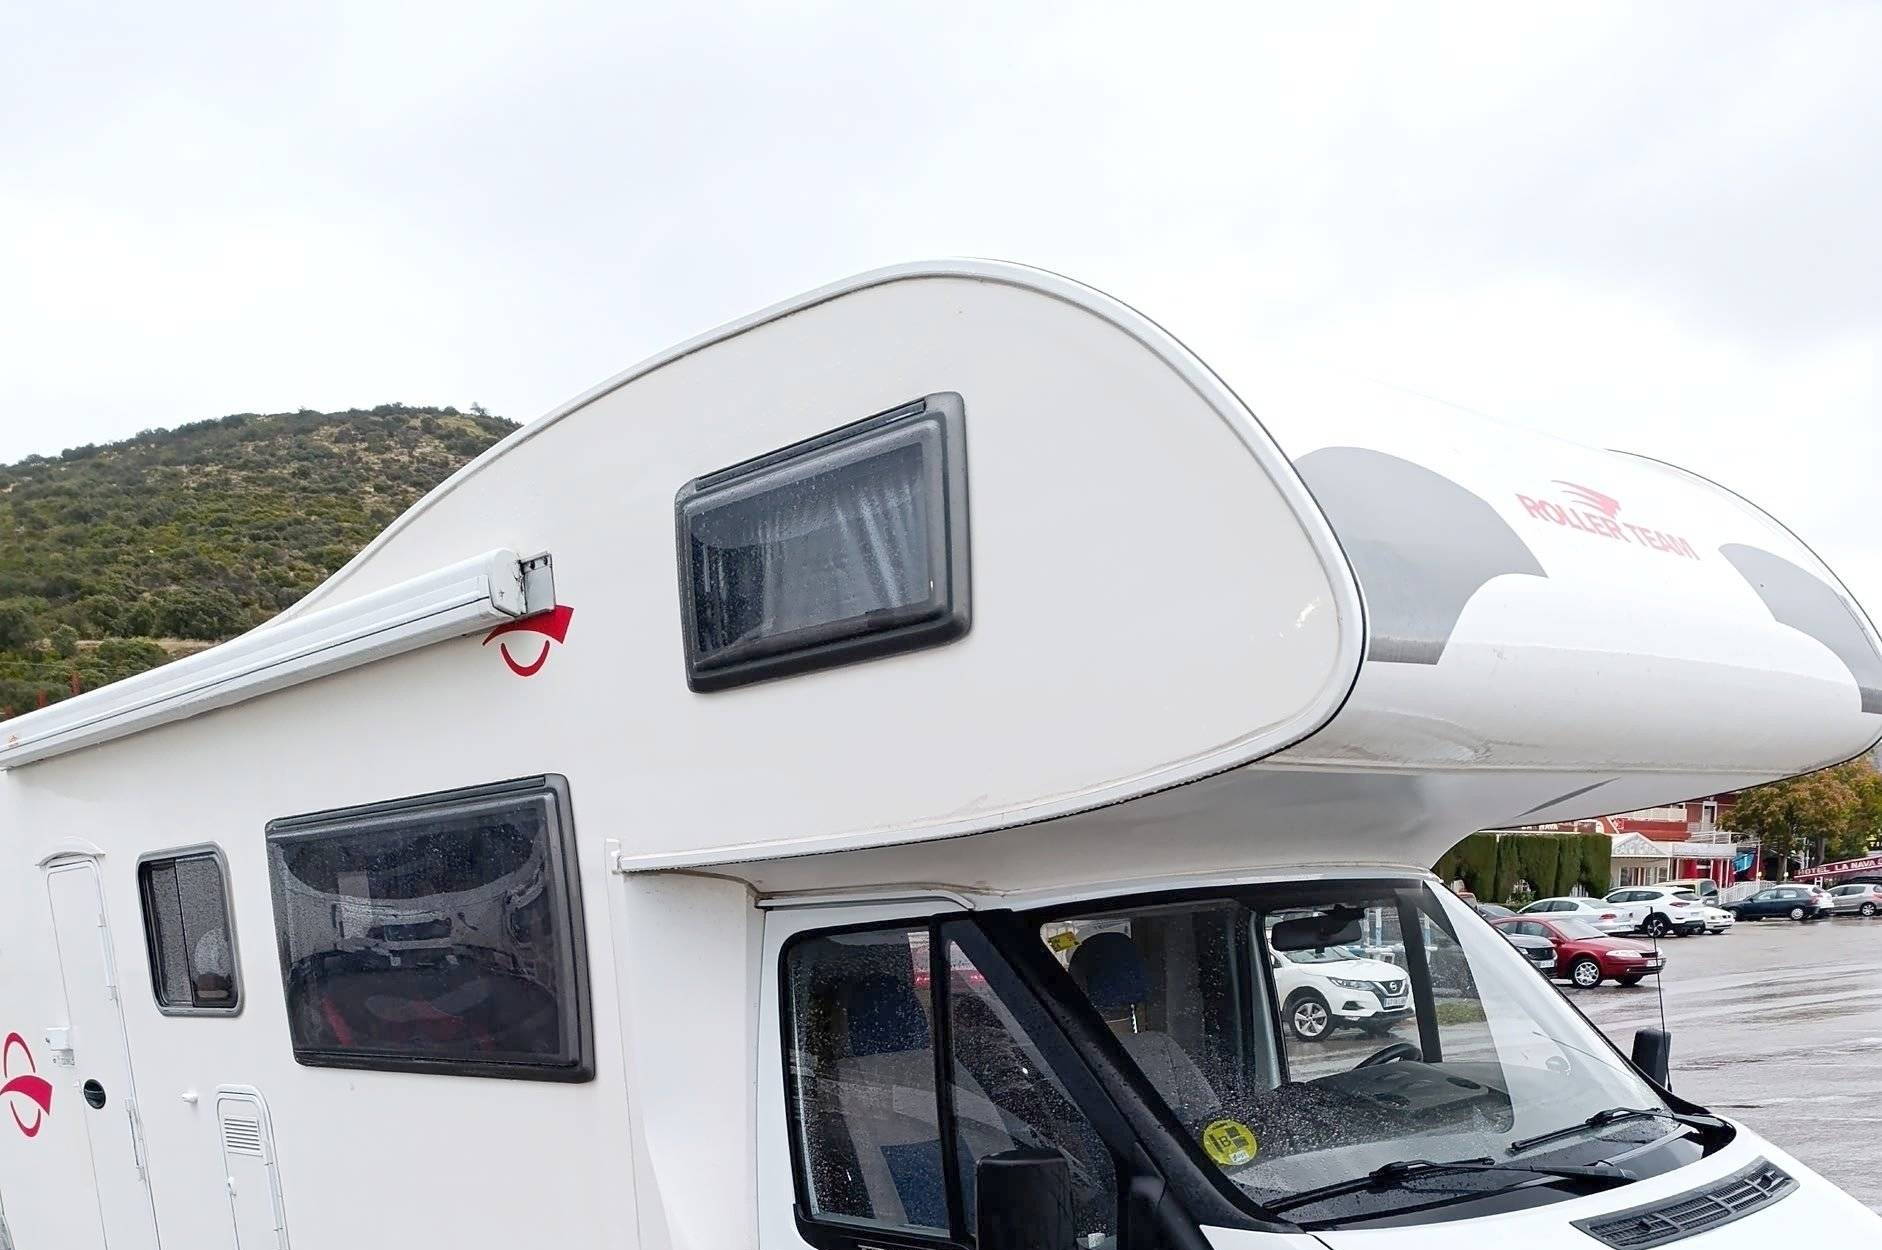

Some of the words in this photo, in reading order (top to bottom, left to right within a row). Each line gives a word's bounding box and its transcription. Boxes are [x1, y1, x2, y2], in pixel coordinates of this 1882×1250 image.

[1515, 493, 1631, 543] ROLLER
[1623, 522, 1701, 561] TEAM
[1798, 866, 1830, 876] HOTEL
[1835, 863, 1849, 871] LA
[1850, 859, 1876, 869] NAVA
[1219, 1136, 1232, 1147] B
